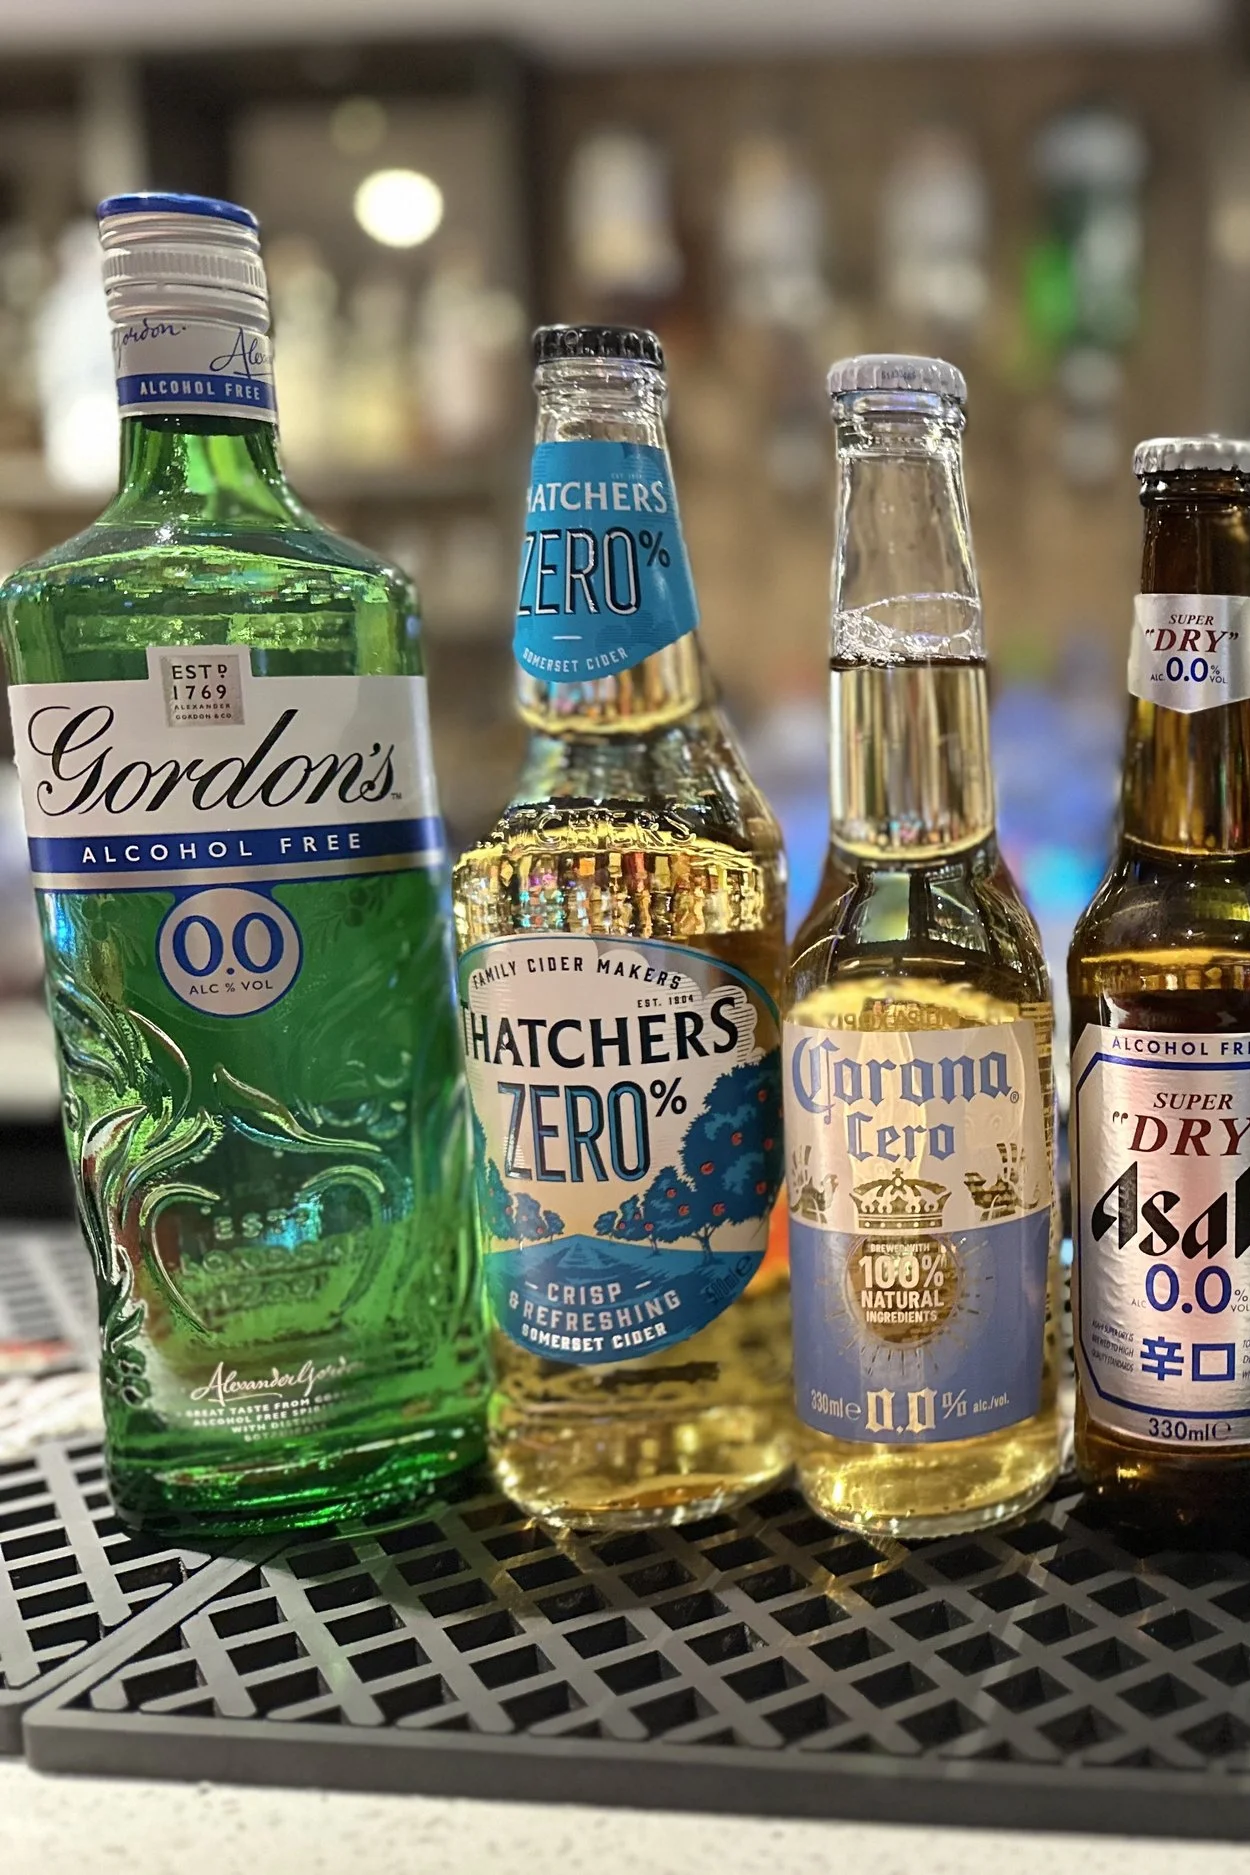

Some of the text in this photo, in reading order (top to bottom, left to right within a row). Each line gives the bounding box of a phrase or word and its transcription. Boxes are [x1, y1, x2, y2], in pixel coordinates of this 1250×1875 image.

[140, 380, 261, 401] ALCOHOL FREE
[1168, 614, 1214, 626] SUPER
[522, 646, 629, 674] SOMERSET CIDER
[1166, 656, 1209, 683] 0.0
[173, 685, 228, 700] 1769
[174, 703, 231, 711] ALEXANDER
[29, 704, 396, 817] Gordon's
[82, 832, 362, 864] ALCOHOL FREE
[172, 912, 285, 978] 0.0
[472, 956, 682, 990] FAMILY CIDER MAKERS
[188, 978, 274, 996] ALC % VOL
[637, 994, 694, 1008] EST. 1904
[459, 996, 739, 1068] THATCHERS
[1112, 1035, 1209, 1056] ALCOHOL
[792, 1036, 1013, 1125] Corona
[1153, 1092, 1234, 1111] SUPER
[846, 1110, 956, 1163] Cero
[870, 1243, 930, 1253] BREWED WITH
[859, 1253, 945, 1289] 100%
[547, 1281, 621, 1306] CRISP
[861, 1290, 945, 1309] NATURAL
[1145, 1263, 1232, 1315] 0.0
[523, 1288, 682, 1333] REFRESHING
[866, 1310, 938, 1324] INGREDIENTS
[521, 1322, 668, 1352] SOMERSET CIDER
[1118, 1346, 1134, 1357] HIGH
[1140, 1335, 1236, 1382] 辛口
[186, 1398, 310, 1418] GREAT TASTE FROM
[811, 1388, 844, 1419] 330ml
[193, 1416, 251, 1427] ALCOHOL
[256, 1410, 287, 1421] FREE
[231, 1423, 266, 1434] WITH
[1149, 1417, 1210, 1441] 330ml
